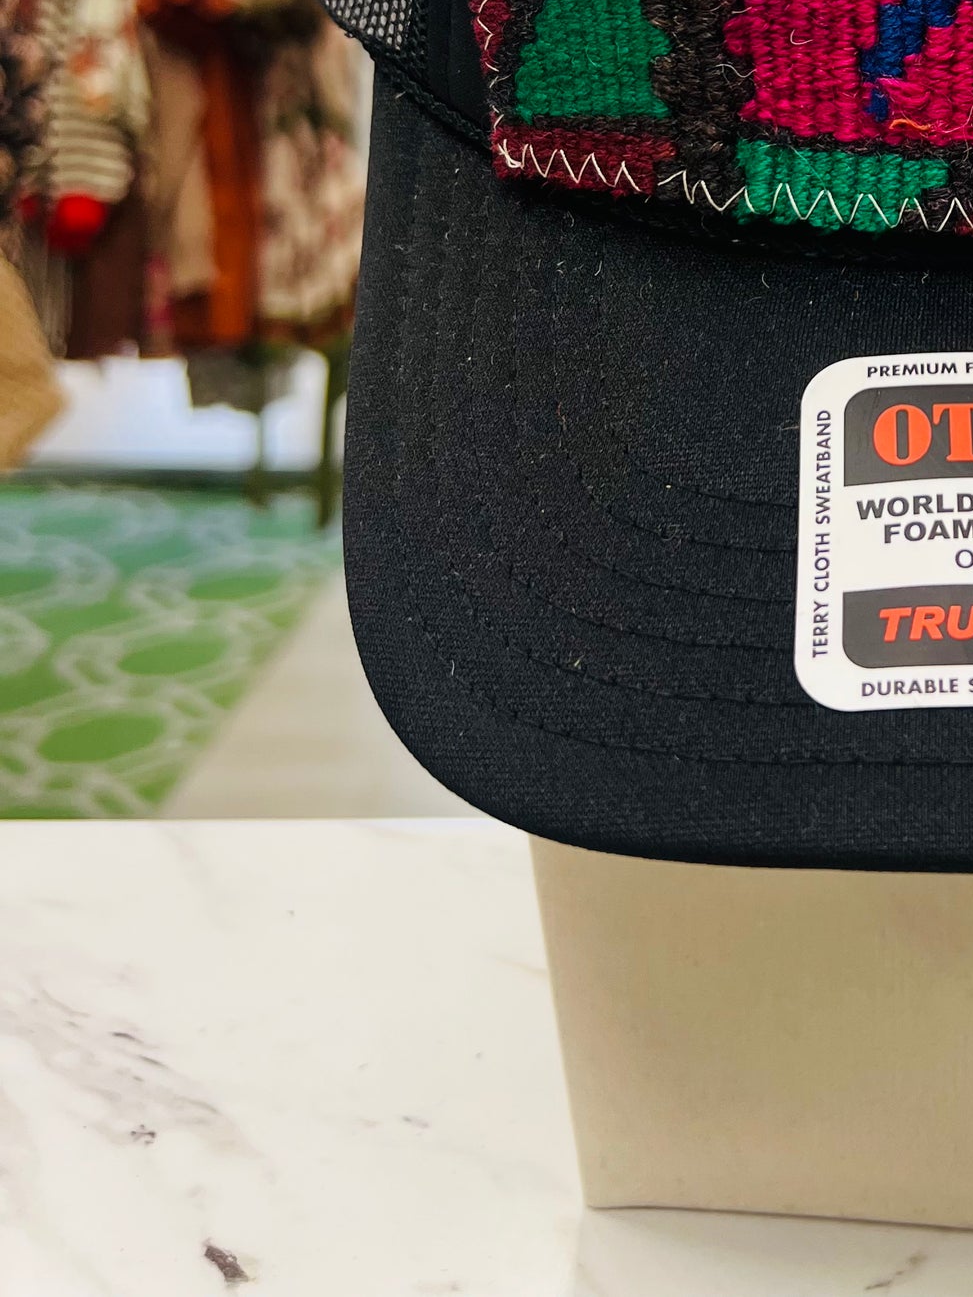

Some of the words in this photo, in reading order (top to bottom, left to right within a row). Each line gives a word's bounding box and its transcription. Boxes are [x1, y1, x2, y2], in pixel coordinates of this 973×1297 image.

[867, 362, 958, 378] PREMIUM
[815, 410, 831, 524] SWEATBAND
[814, 533, 831, 591] CLOTH
[812, 601, 828, 658] TERRY
[861, 678, 959, 697] DURABLE
